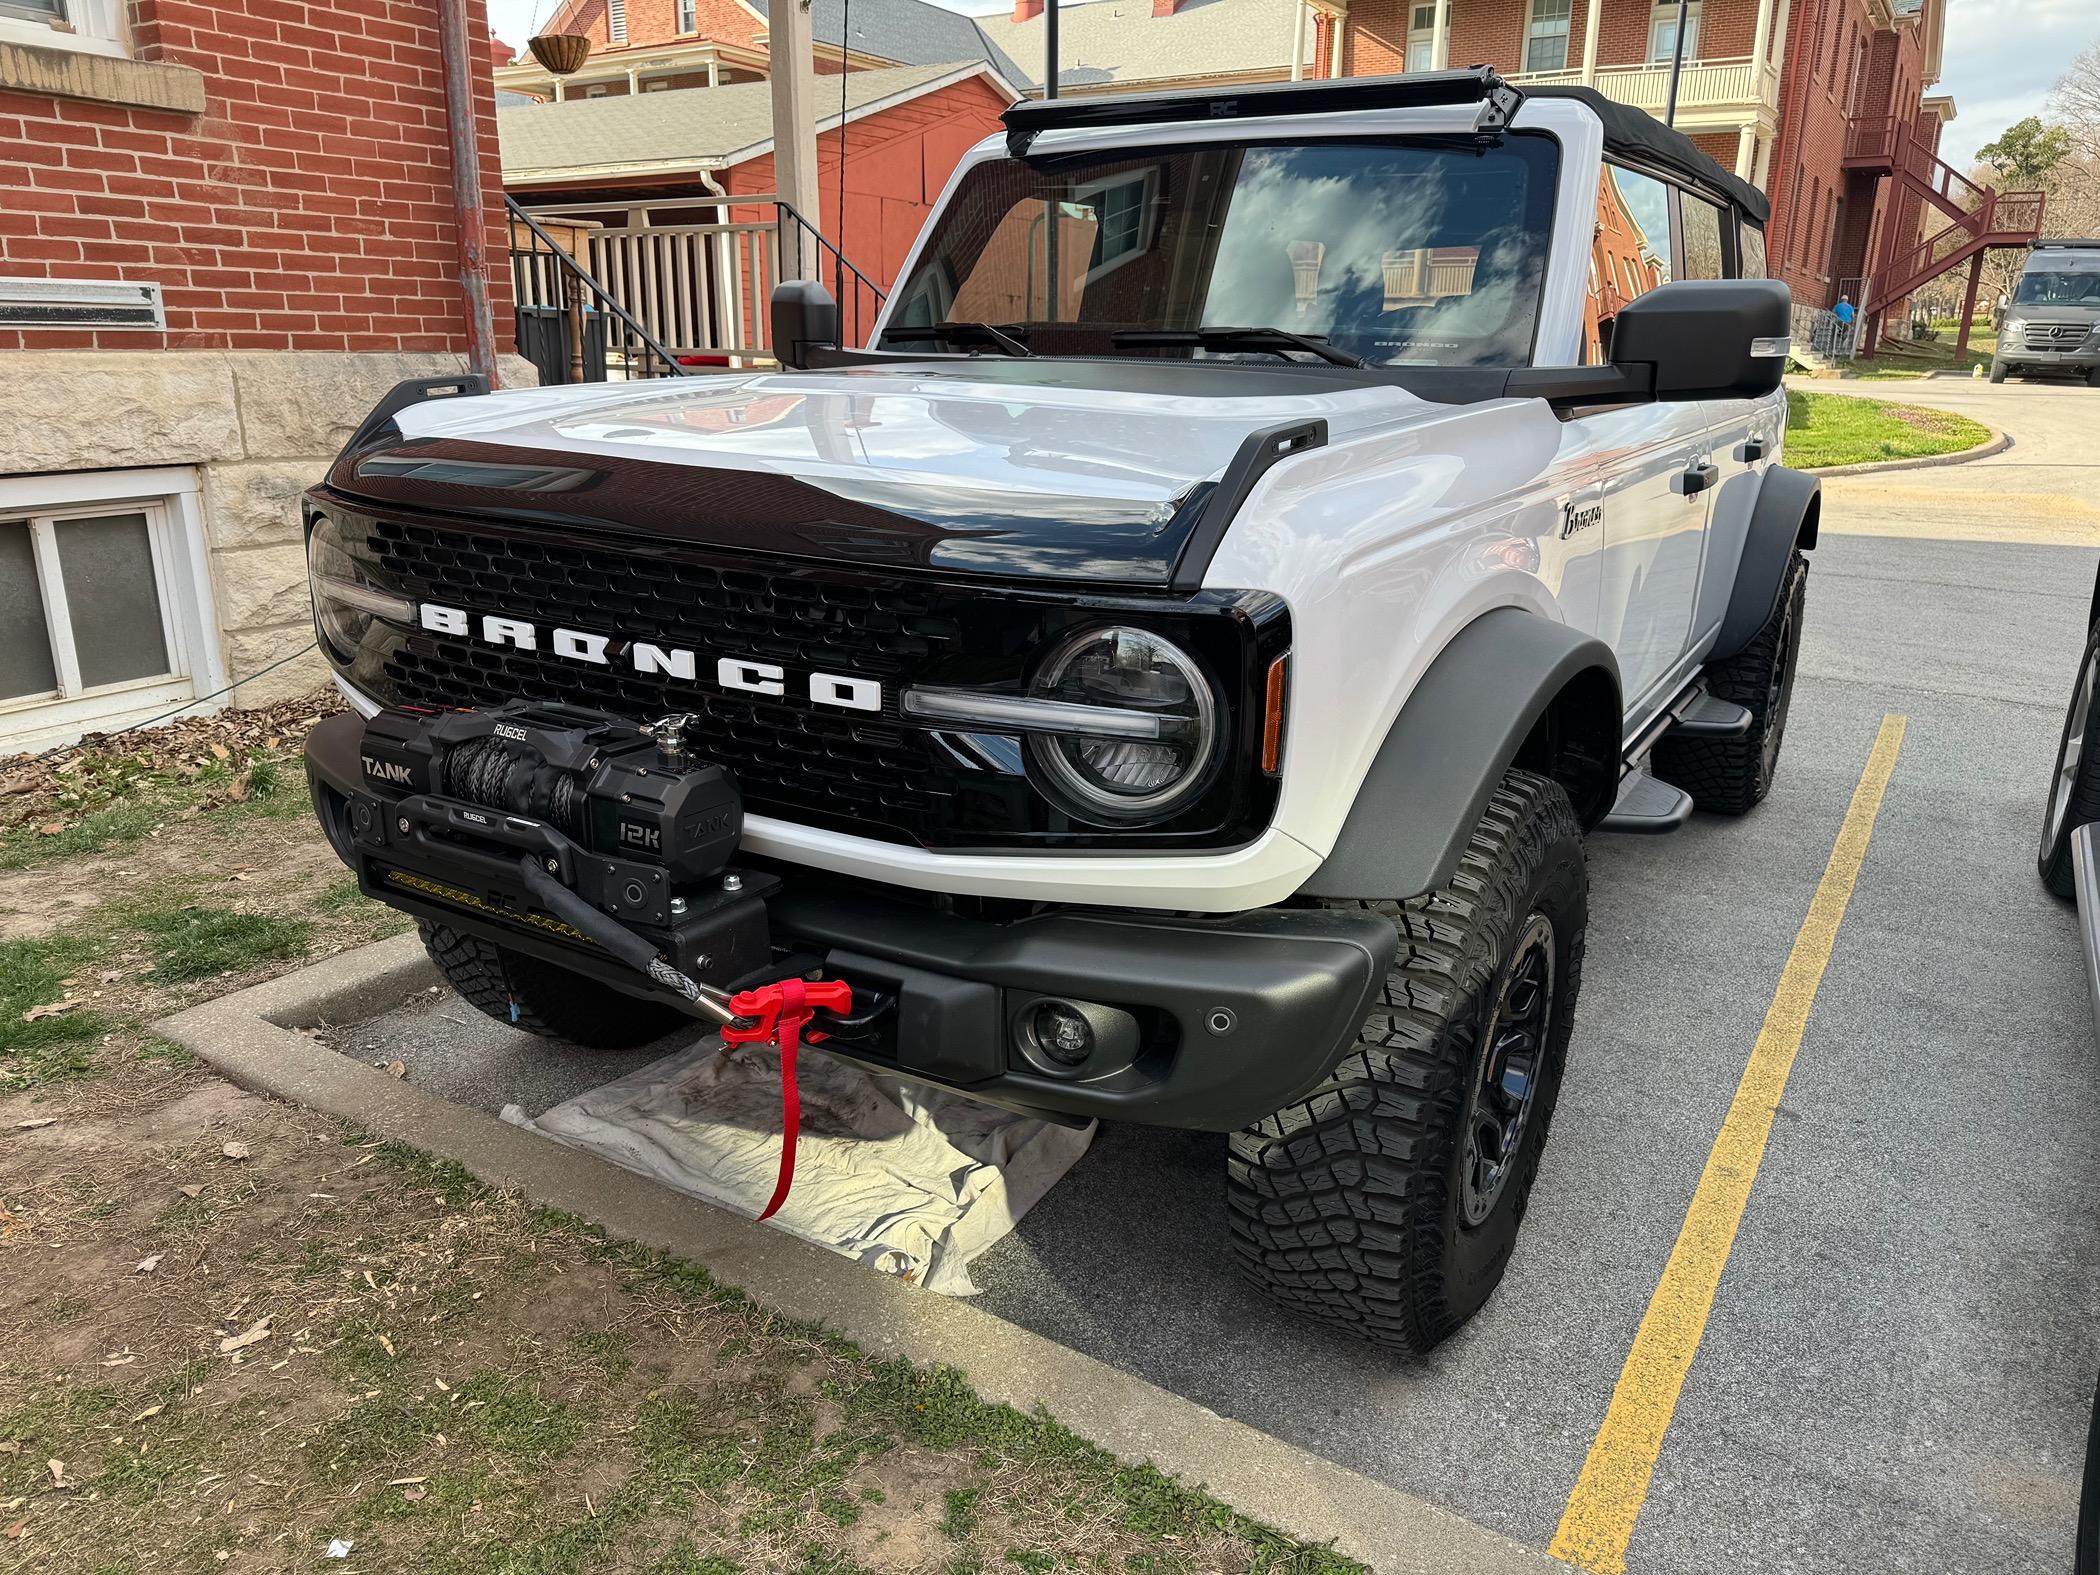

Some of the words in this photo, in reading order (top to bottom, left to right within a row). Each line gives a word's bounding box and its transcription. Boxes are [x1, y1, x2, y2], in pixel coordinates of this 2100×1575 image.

[420, 603, 882, 712] BRONCO
[493, 723, 528, 742] RUGCEL
[361, 755, 414, 786] TANK
[463, 811, 488, 824] RUGCEL
[620, 822, 660, 849] 12K
